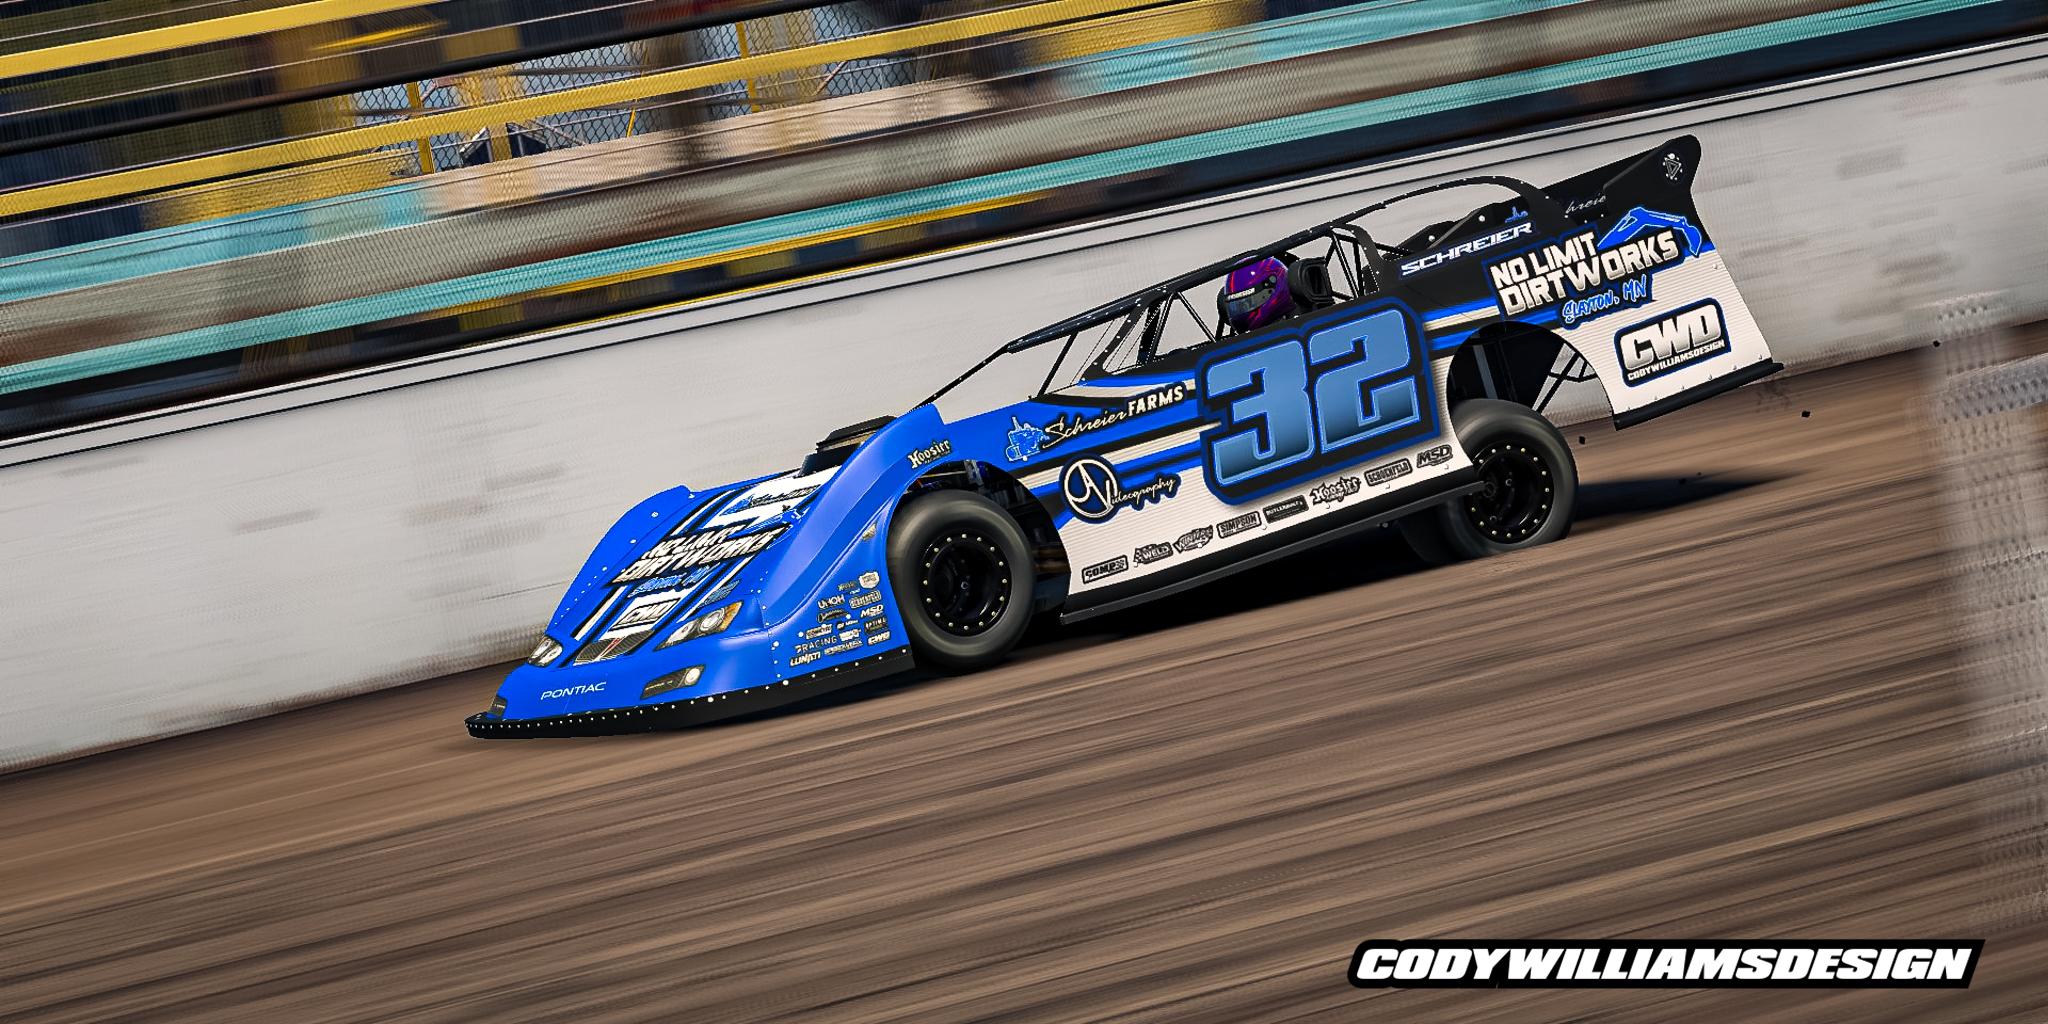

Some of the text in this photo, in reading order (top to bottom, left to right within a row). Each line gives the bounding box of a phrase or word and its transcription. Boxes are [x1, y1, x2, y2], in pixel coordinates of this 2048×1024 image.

[1401, 222, 1533, 276] SCHREIER
[1490, 231, 1599, 289] NO LIMIT
[1499, 230, 1679, 316] DIRTWORKS
[1622, 273, 1648, 304] MN
[1620, 304, 1721, 370] CWD
[1627, 339, 1725, 381] CODYWILLIAMSDESIGN
[1042, 386, 1184, 449] Schreier FARMS
[1207, 308, 1421, 487] 32
[1418, 445, 1451, 466] MSD
[1220, 512, 1258, 533] SIMPSON
[1142, 545, 1171, 561] WELD
[860, 604, 884, 618] MSD
[541, 681, 607, 701] PONTIAC
